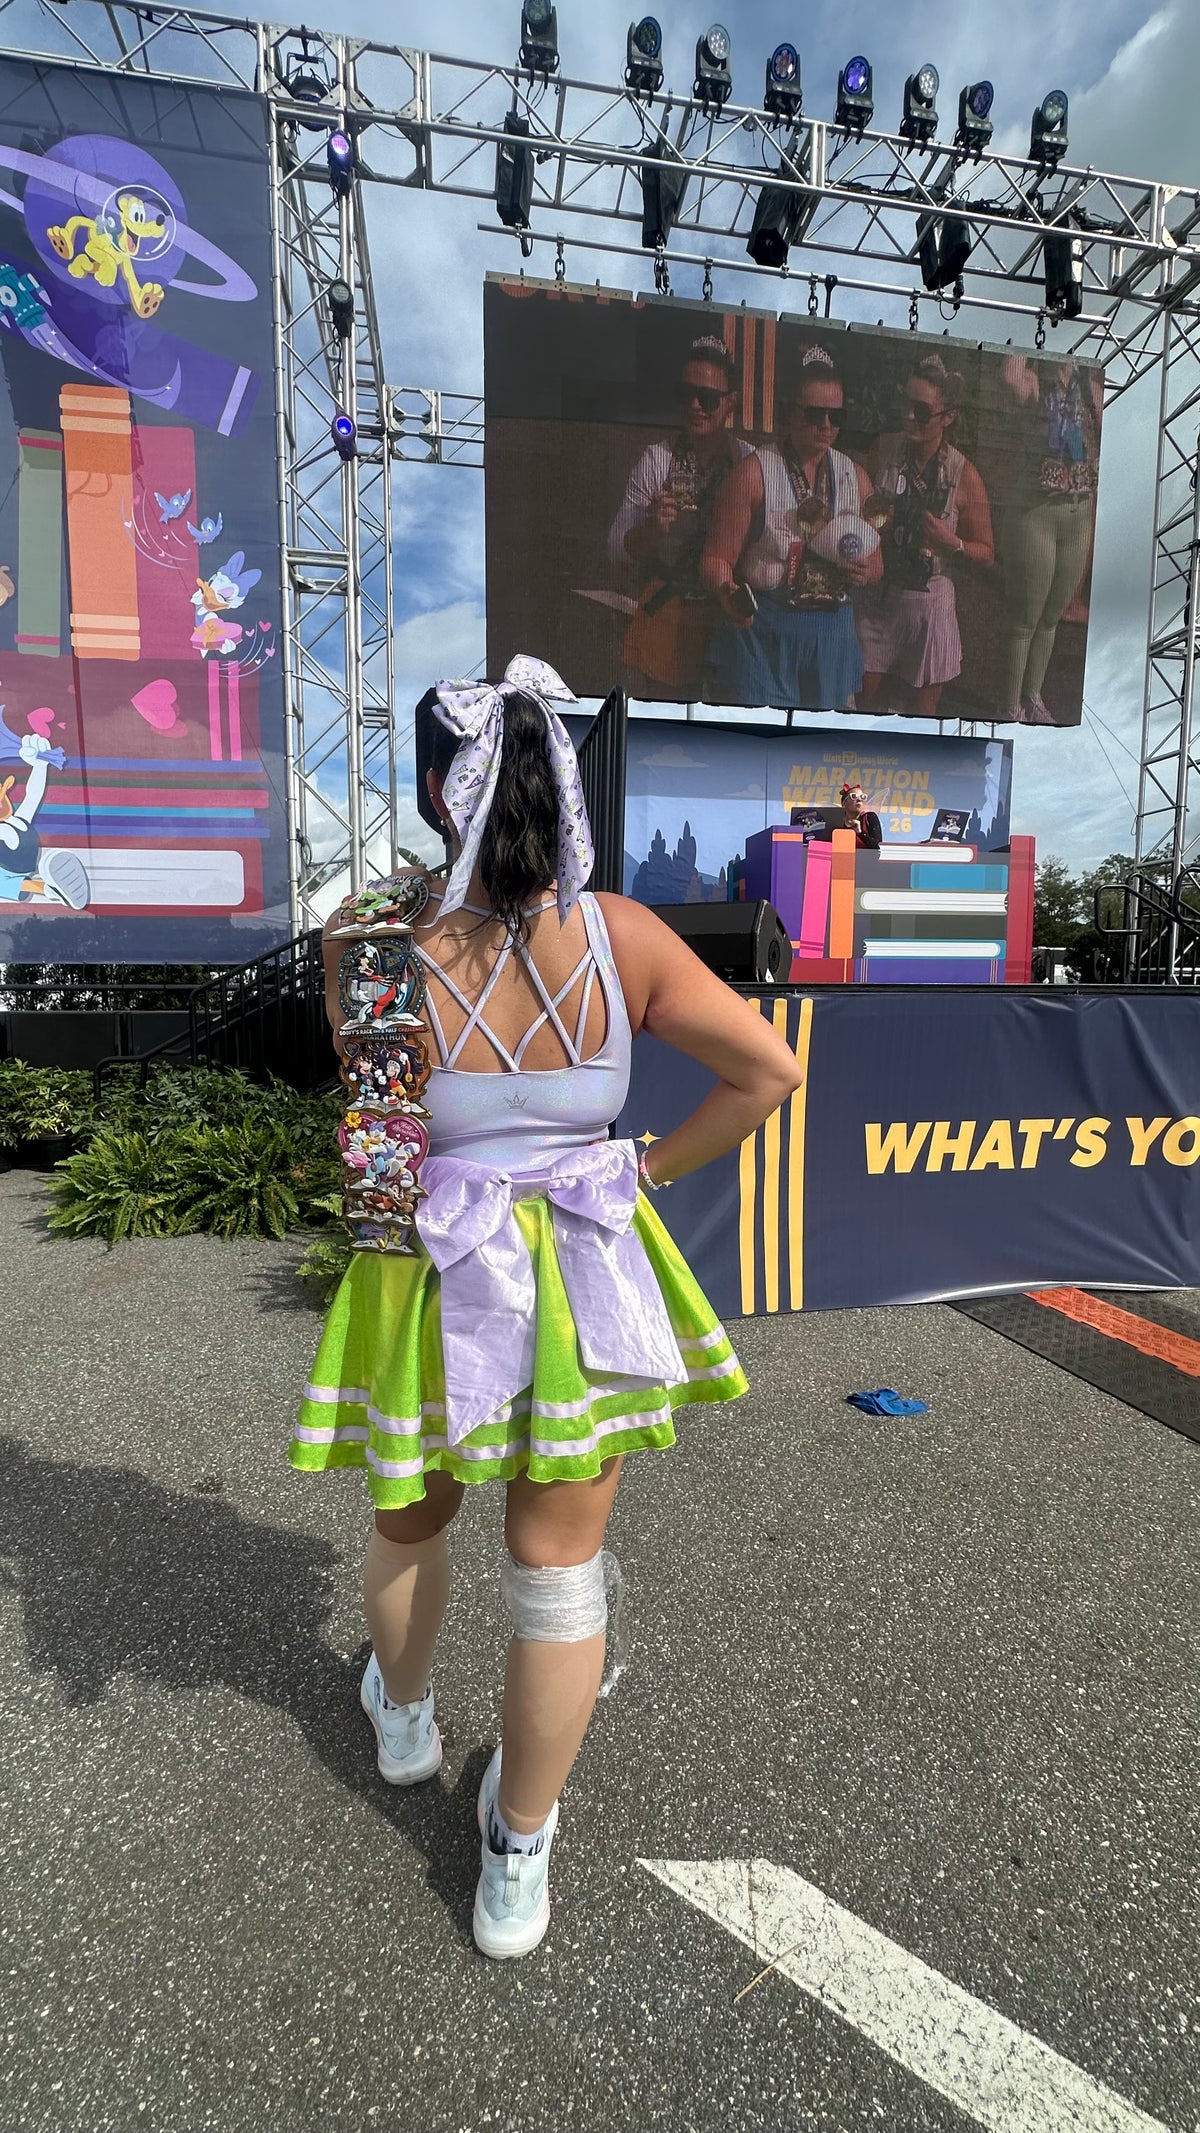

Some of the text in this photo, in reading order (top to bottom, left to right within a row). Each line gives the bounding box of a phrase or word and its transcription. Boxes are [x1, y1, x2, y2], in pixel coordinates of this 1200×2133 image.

[789, 765, 930, 789] MARATHON
[889, 818, 912, 834] 26
[864, 1117, 1112, 1175] WHAT'S
